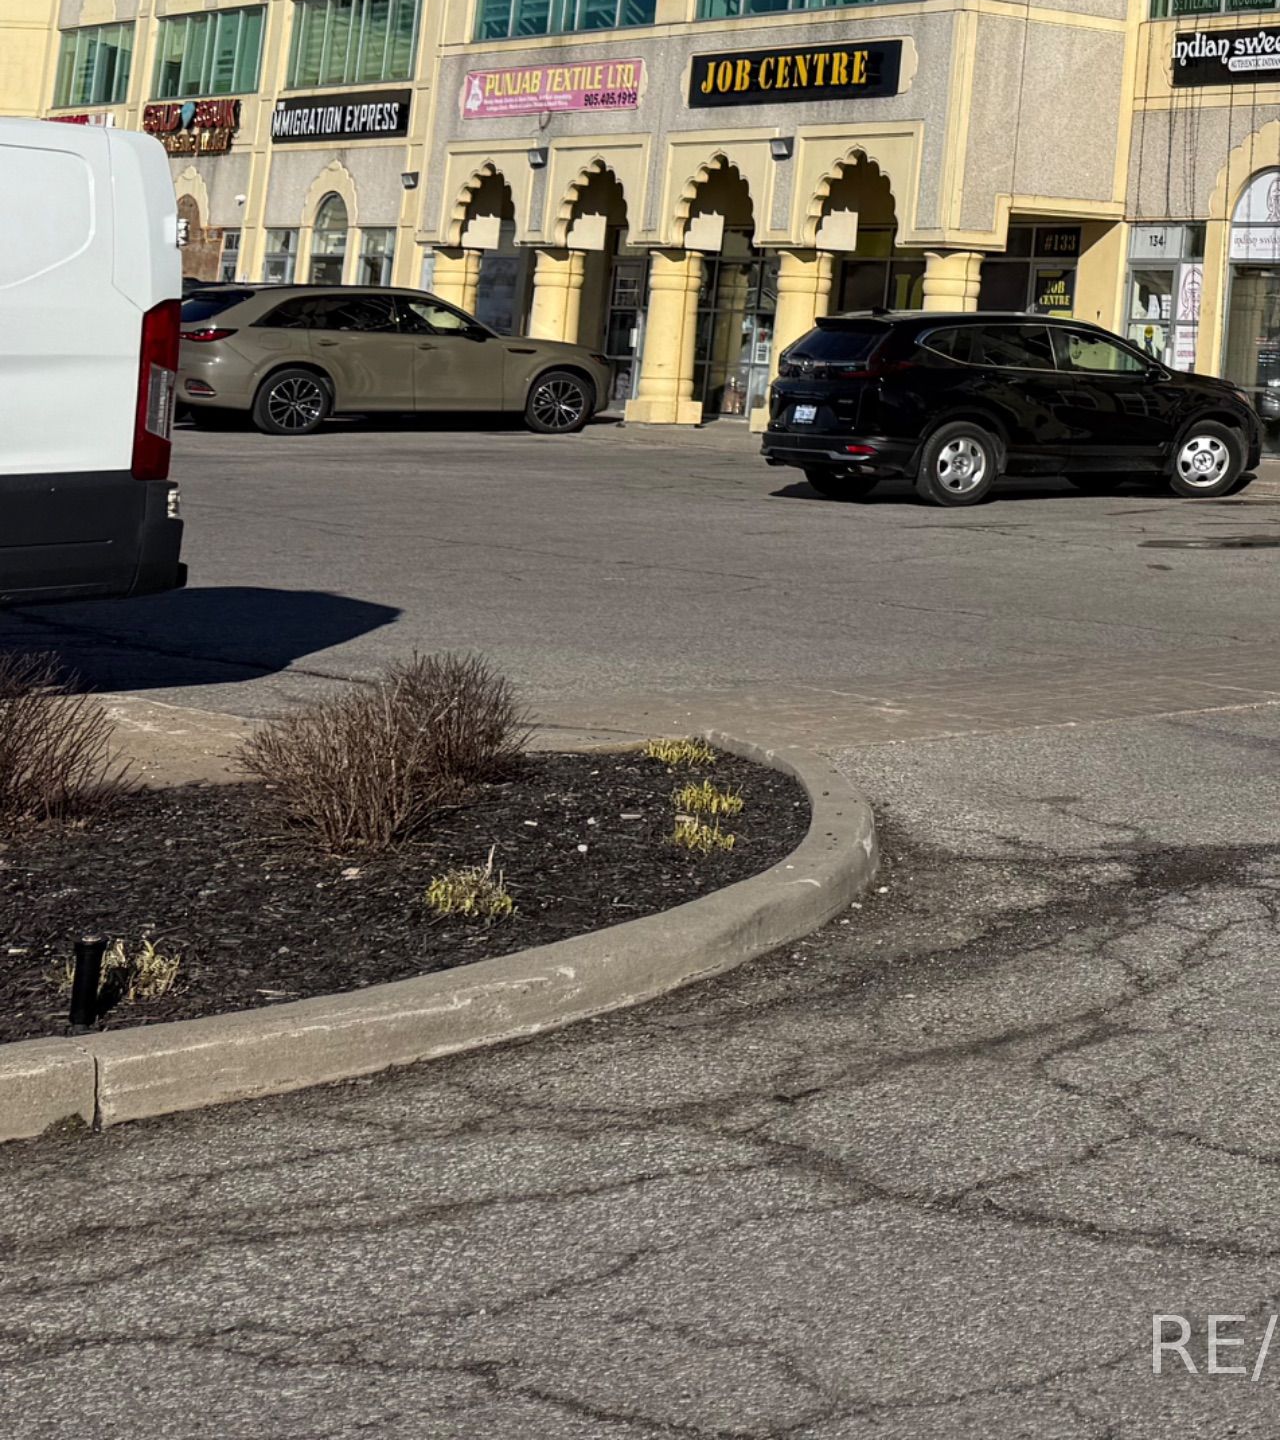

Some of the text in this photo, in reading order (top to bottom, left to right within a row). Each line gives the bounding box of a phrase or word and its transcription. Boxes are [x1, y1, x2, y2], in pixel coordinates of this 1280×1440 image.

[485, 64, 638, 96] PUNJAB TEXTILE LTD.
[701, 50, 869, 93] JOB CENTRE
[344, 102, 400, 132] EXPRESS
[1044, 234, 1076, 251] #133
[1149, 235, 1166, 247] 134
[1046, 280, 1066, 294] JOB
[1039, 294, 1071, 306] CENTRE
